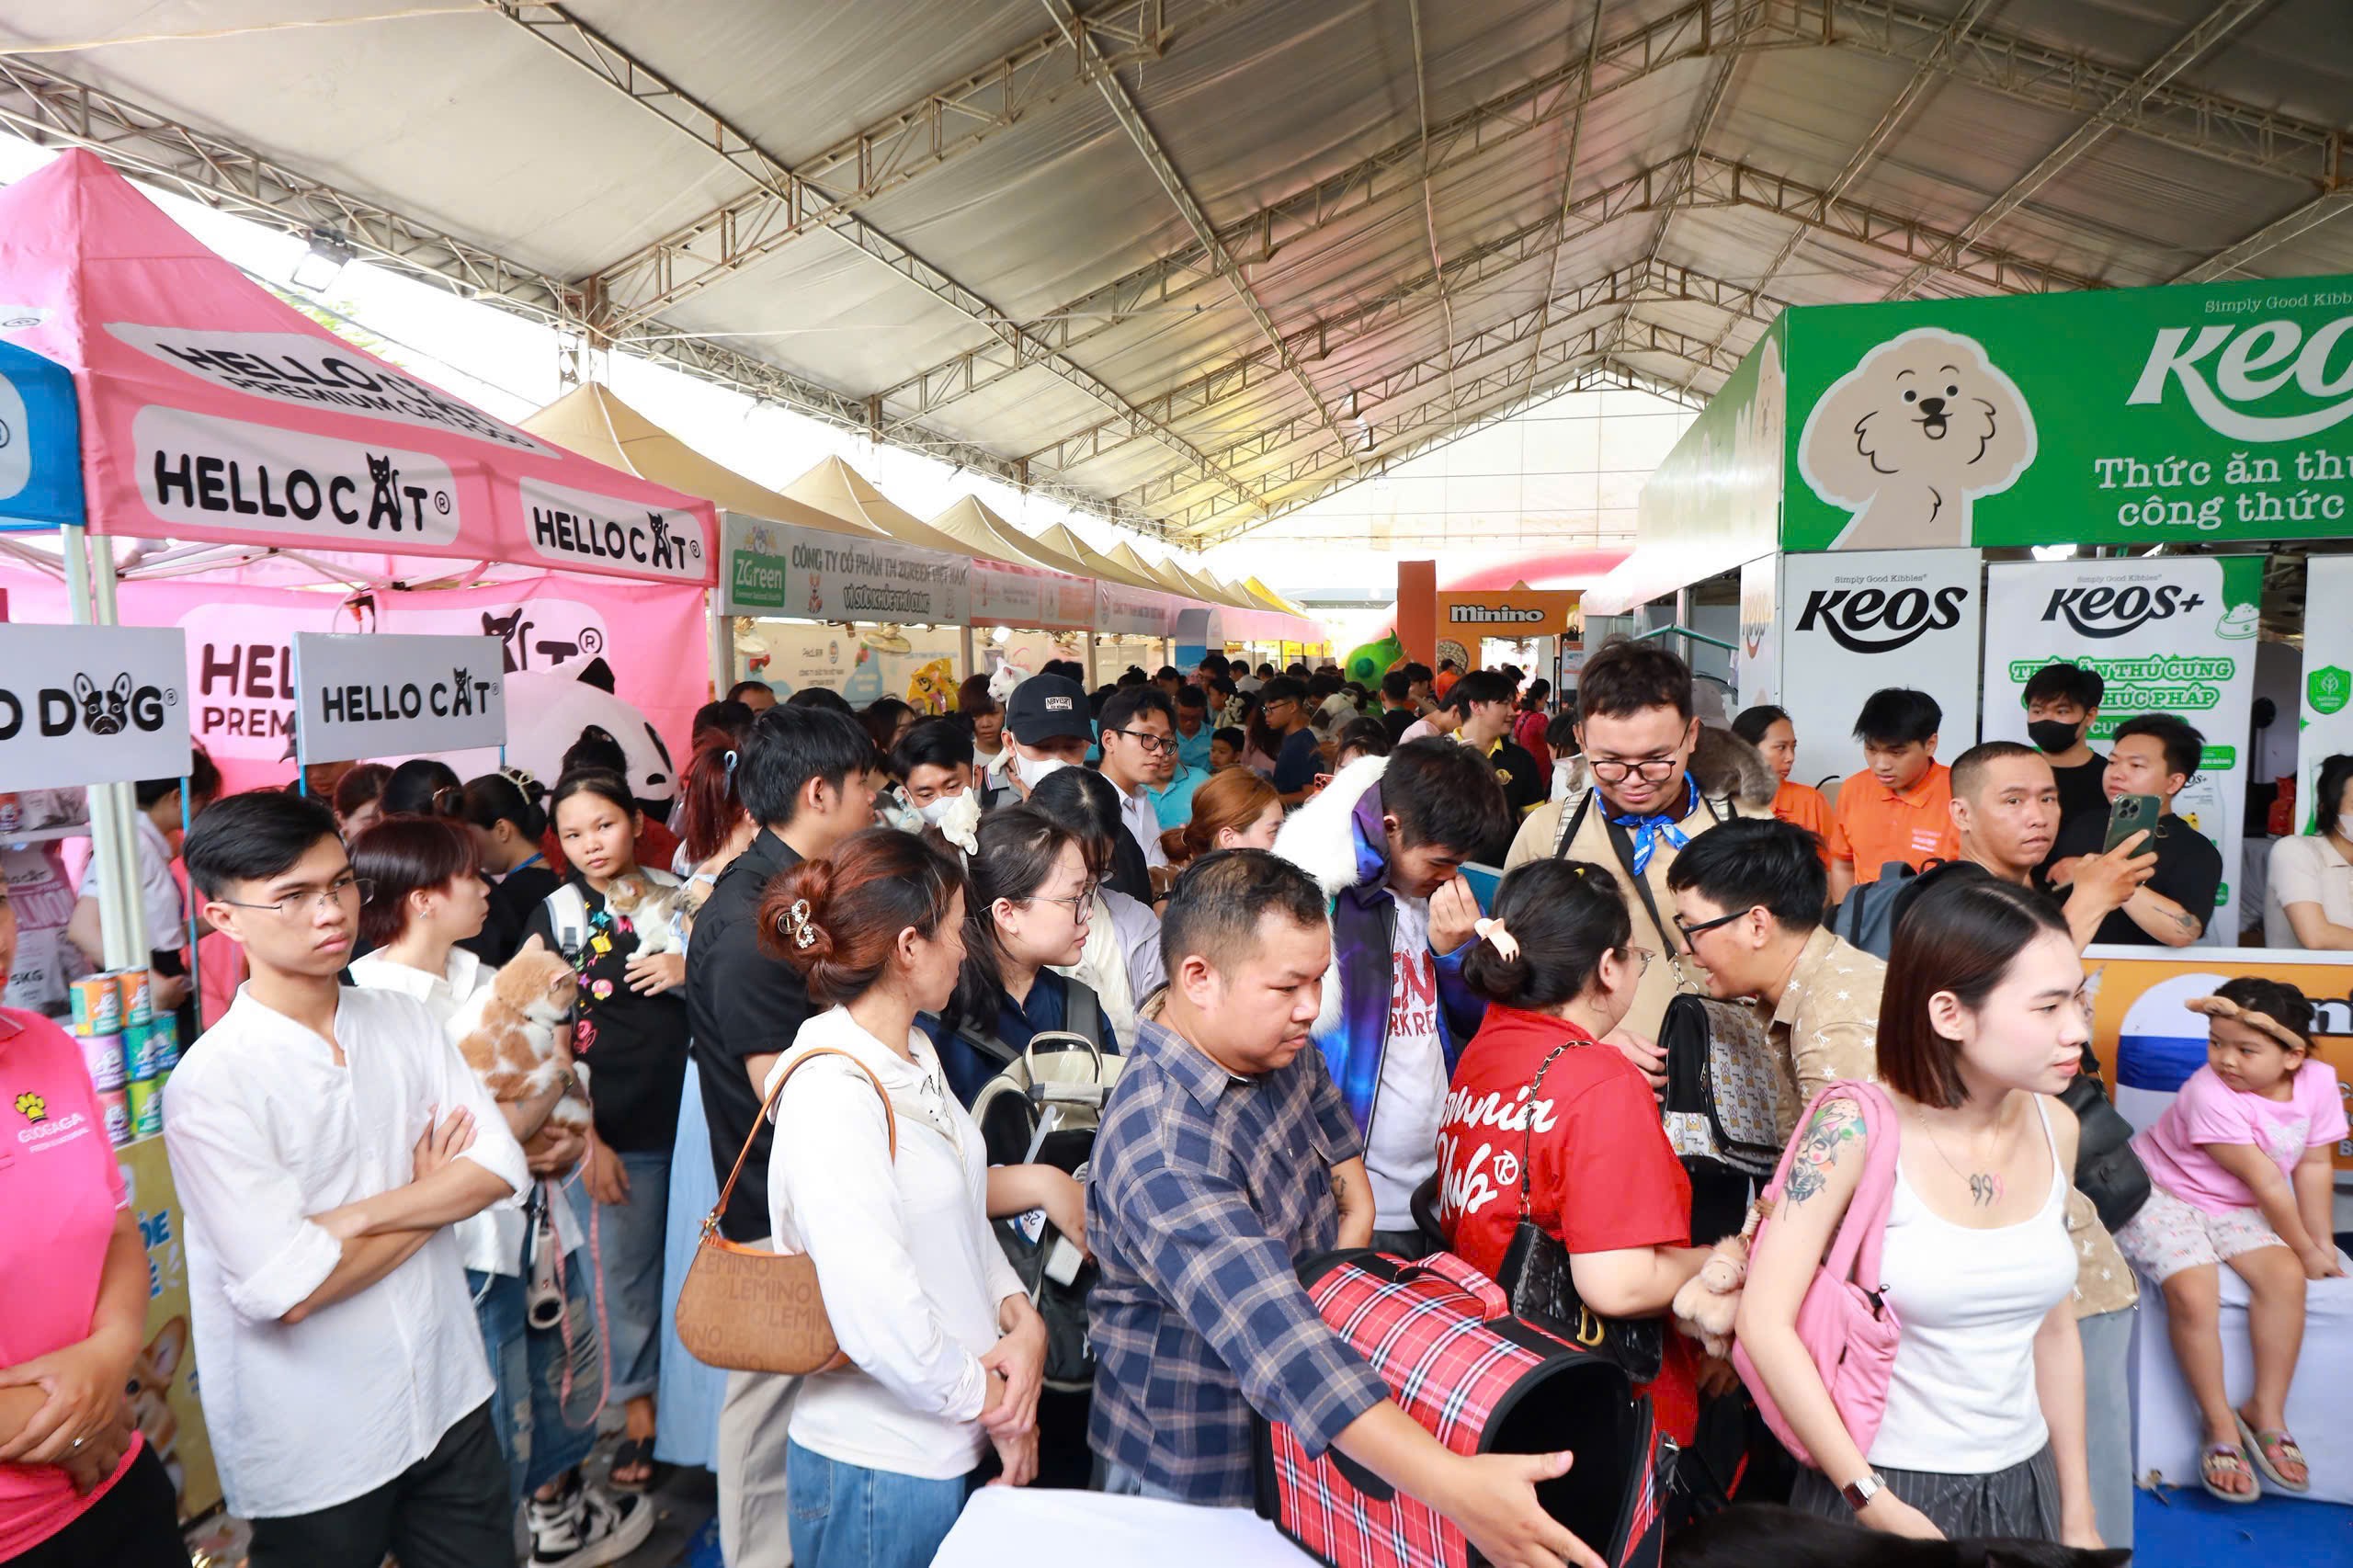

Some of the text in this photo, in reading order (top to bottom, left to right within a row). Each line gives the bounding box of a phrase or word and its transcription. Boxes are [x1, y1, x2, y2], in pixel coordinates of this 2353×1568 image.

[2205, 297, 2262, 313] Simply
[2266, 294, 2308, 309] Good
[155, 342, 383, 393] HELLO
[219, 375, 404, 415] PREMIUM
[397, 400, 456, 426] CAT
[153, 449, 322, 522] HELLO
[2094, 455, 2211, 490] Thức
[2224, 451, 2281, 485] ăn
[2118, 489, 2345, 530] công thức
[533, 506, 623, 560] HELLO
[735, 558, 782, 589] ZGreen
[792, 541, 823, 571] CÔNG
[824, 549, 838, 573] TY
[1834, 575, 1865, 585] Simply
[1867, 574, 1889, 584] Good
[2076, 575, 2105, 585] Simply
[2106, 574, 2127, 583] Good
[201, 706, 295, 738] PREM
[322, 681, 422, 724] HELLO
